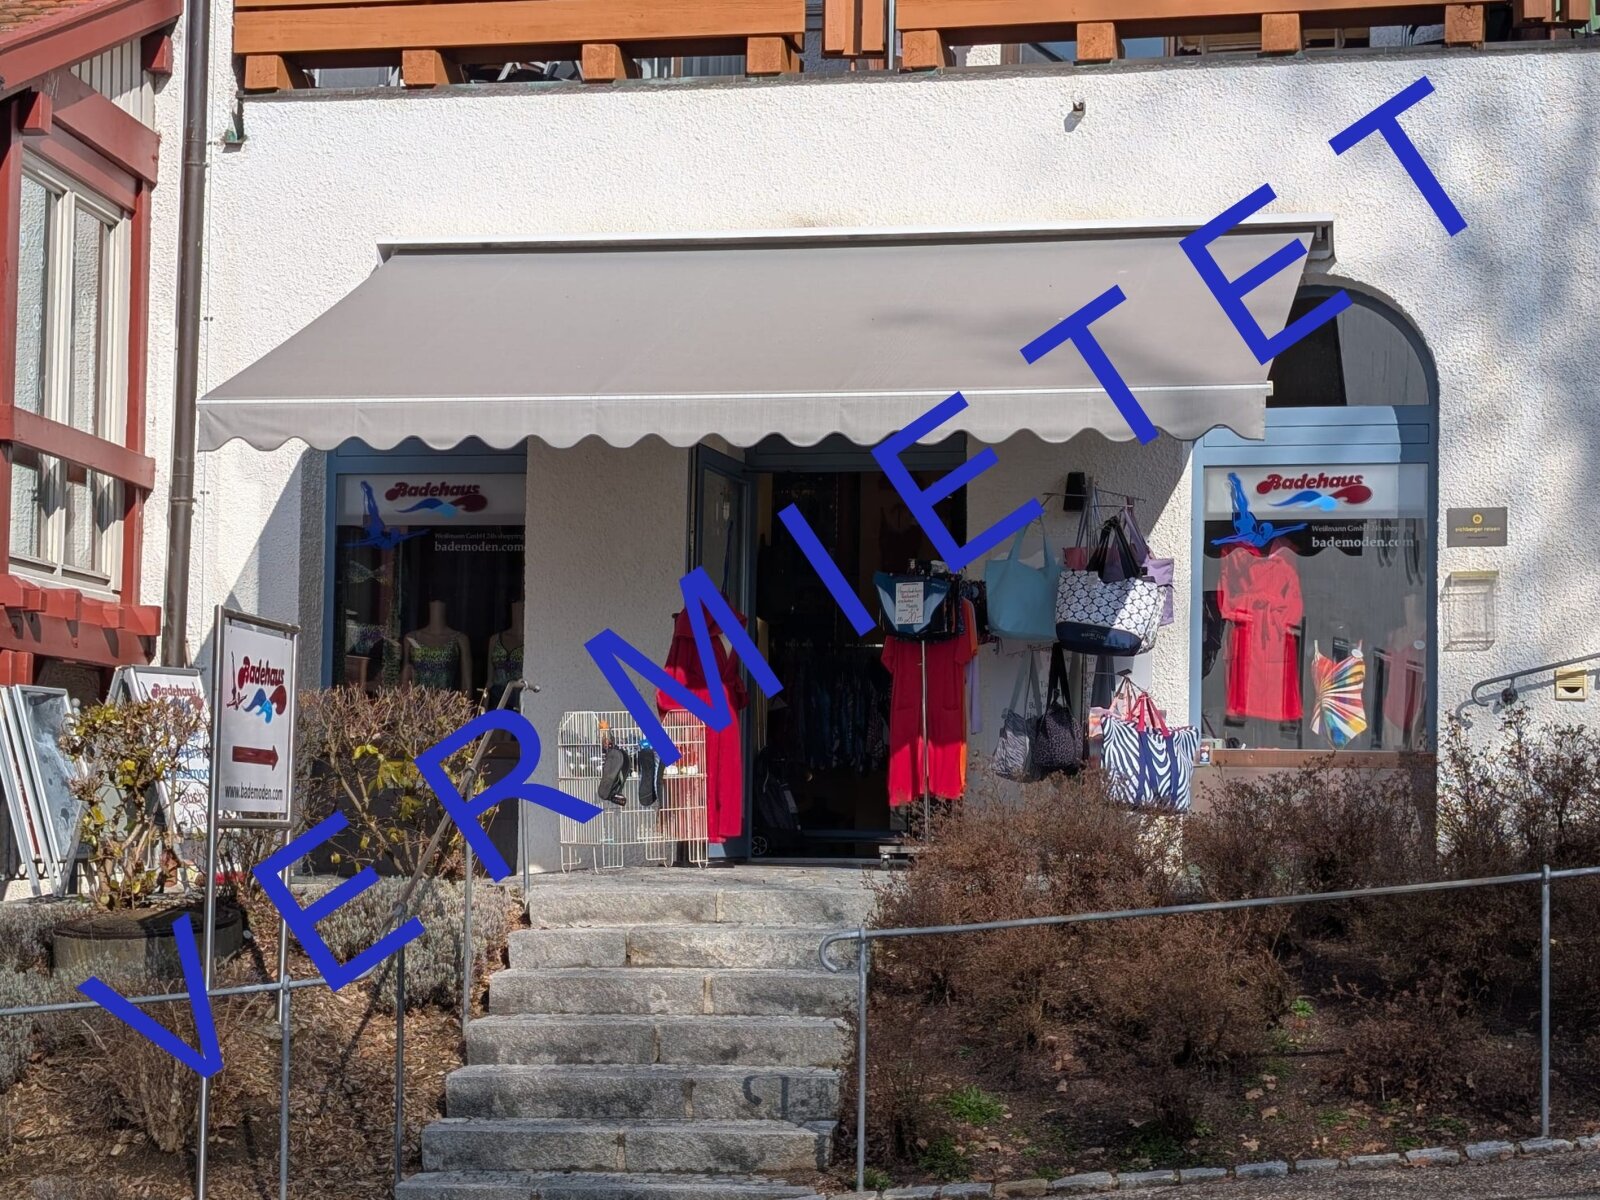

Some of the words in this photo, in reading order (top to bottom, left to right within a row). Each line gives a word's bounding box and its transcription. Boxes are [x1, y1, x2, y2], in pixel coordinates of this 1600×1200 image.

[385, 481, 480, 501] Badehaus
[1256, 472, 1365, 494] Badehaus
[434, 541, 524, 552] bademoden.com
[1312, 536, 1415, 548] bademoden.com
[238, 655, 285, 690] Badehaus
[151, 682, 197, 698] Badehaus
[224, 782, 284, 801] www.bademoden.com
